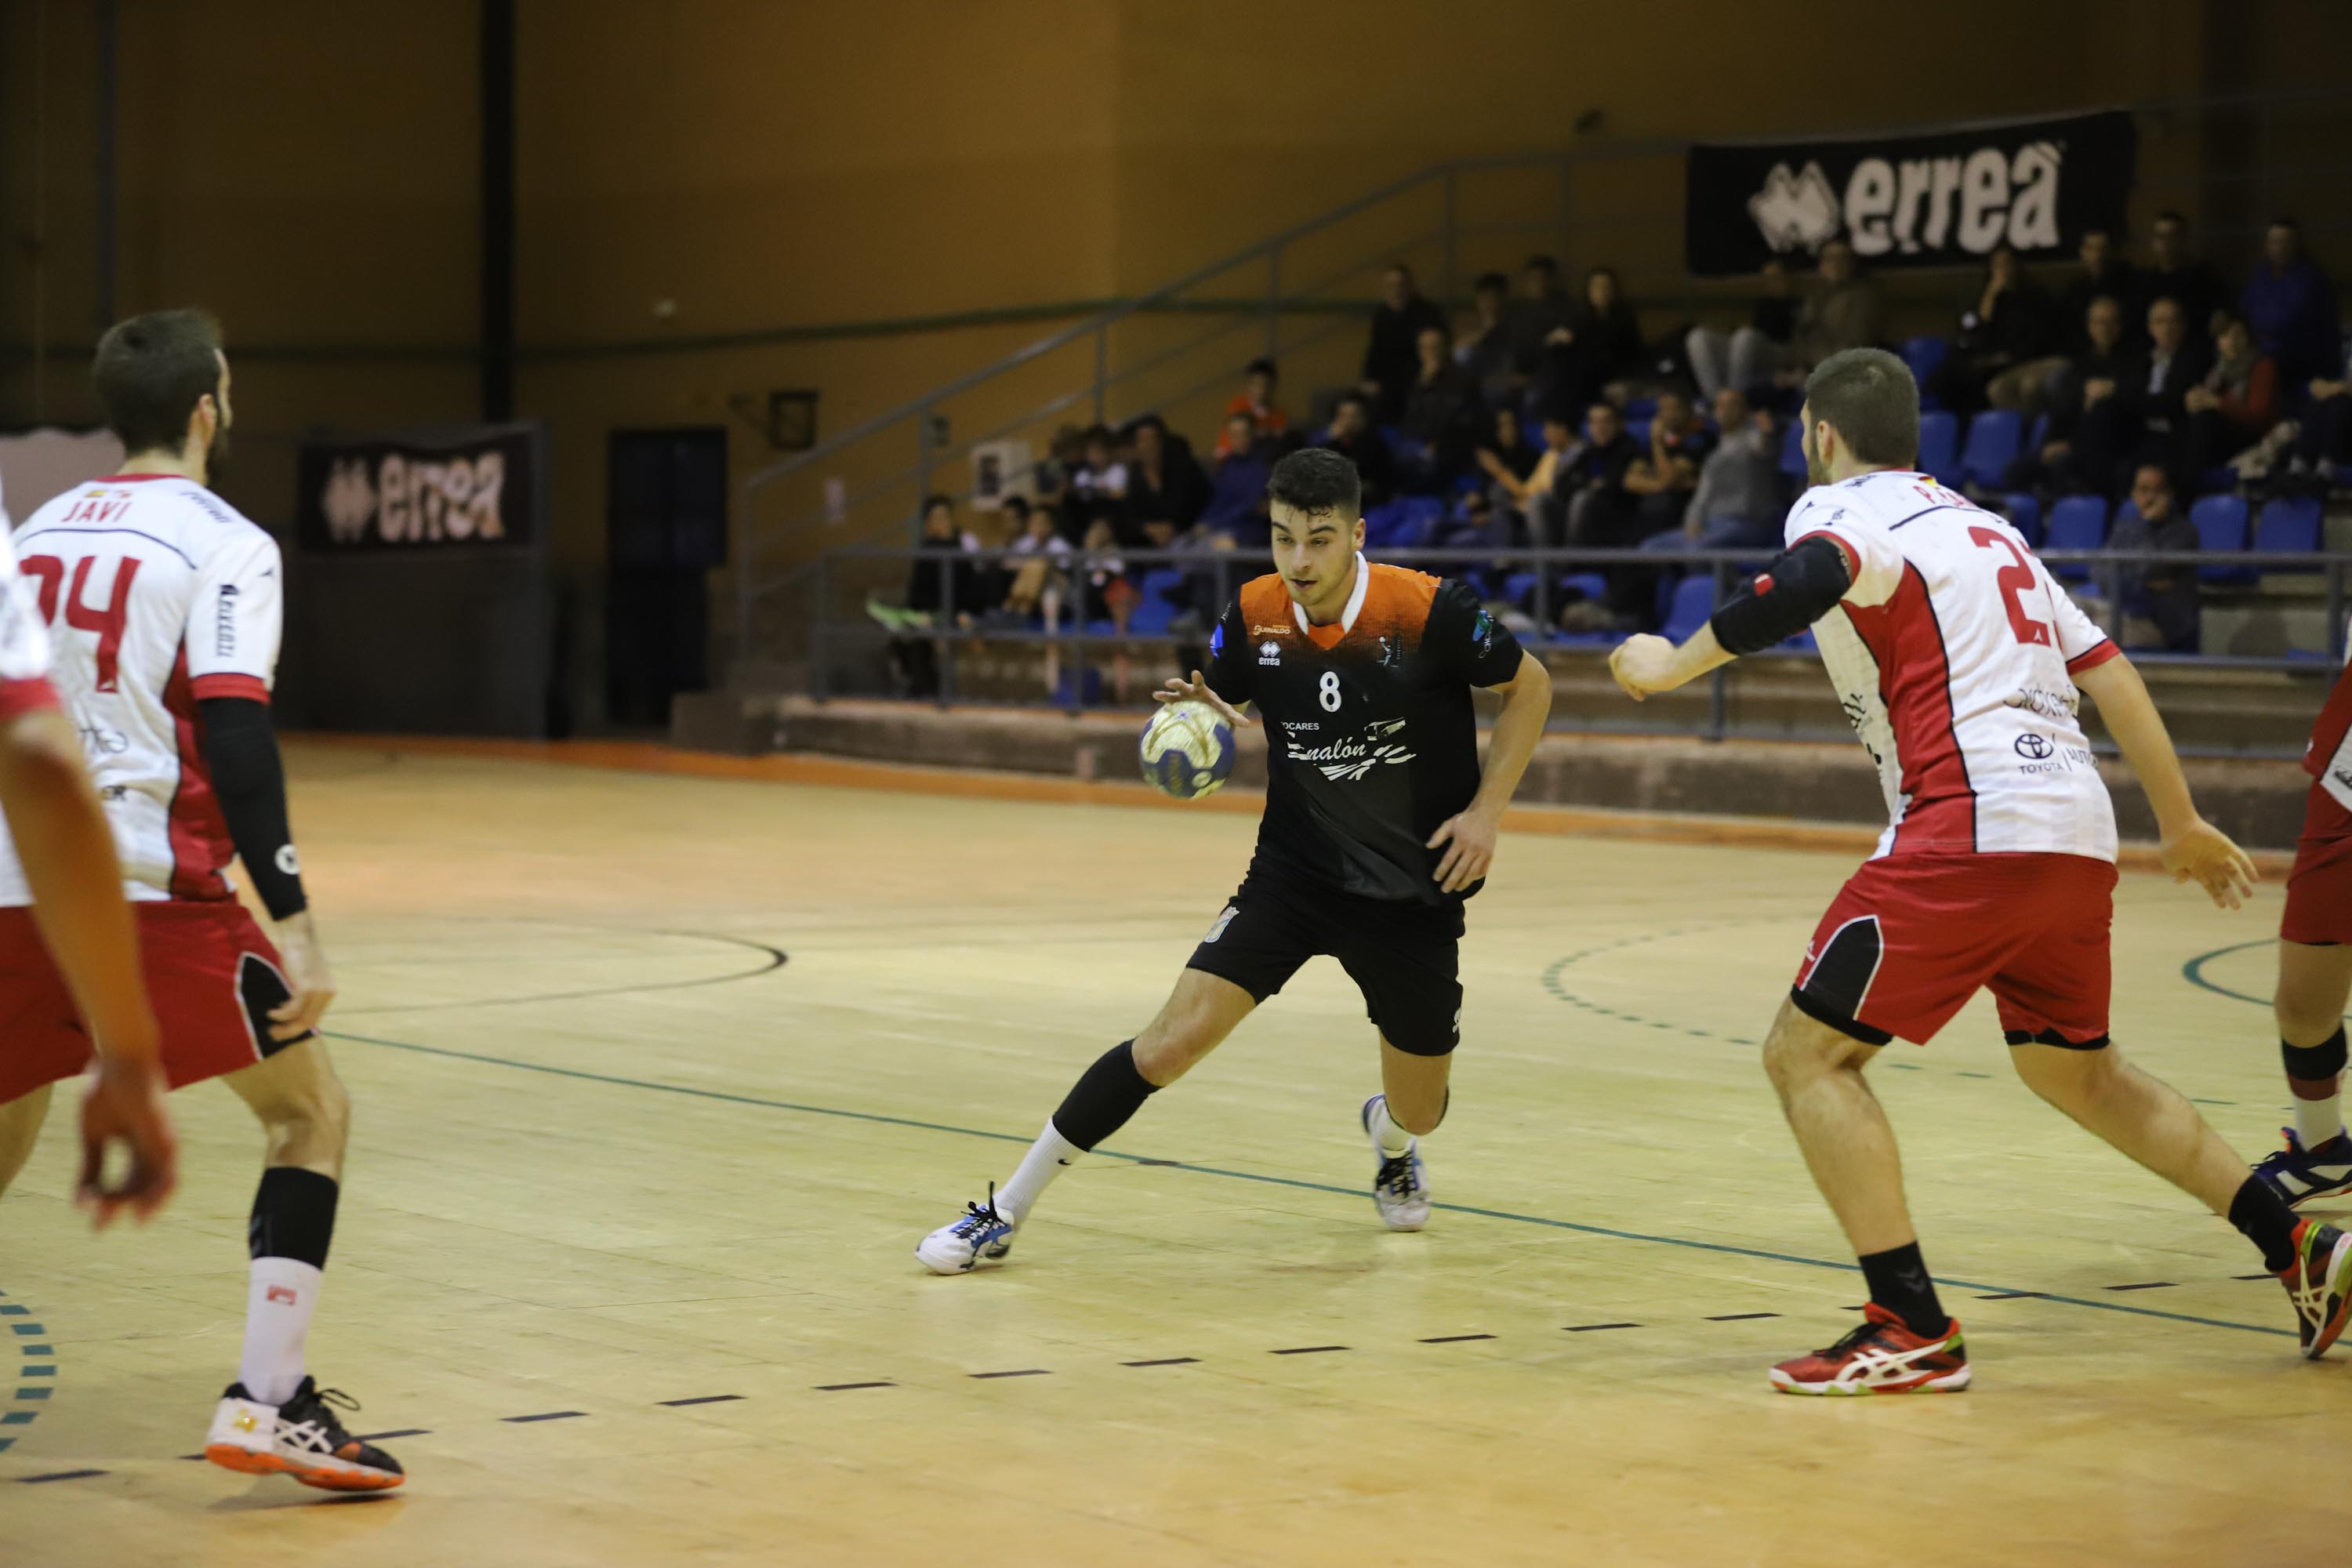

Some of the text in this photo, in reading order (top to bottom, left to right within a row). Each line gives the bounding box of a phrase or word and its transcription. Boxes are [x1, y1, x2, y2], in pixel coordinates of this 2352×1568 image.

[62, 501, 132, 523] JAVI
[1319, 670, 1342, 713] 8
[2020, 762, 2064, 775] TOYOTA
